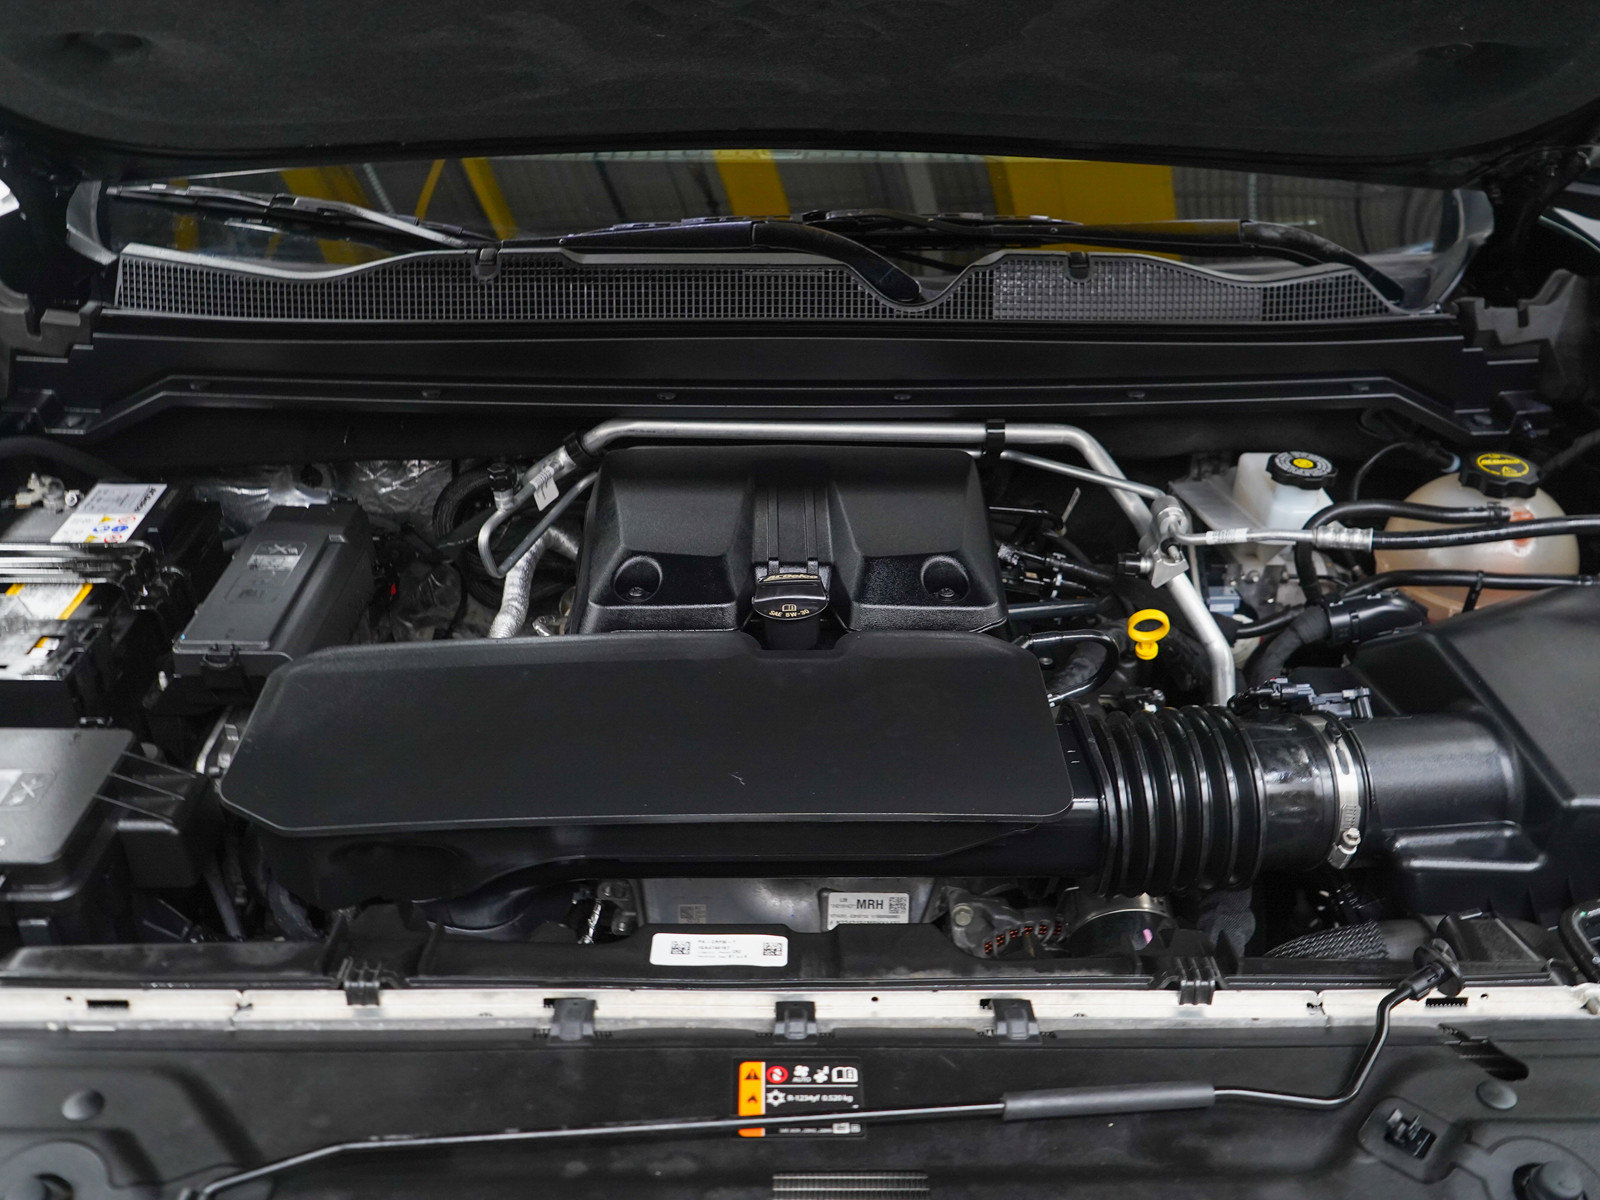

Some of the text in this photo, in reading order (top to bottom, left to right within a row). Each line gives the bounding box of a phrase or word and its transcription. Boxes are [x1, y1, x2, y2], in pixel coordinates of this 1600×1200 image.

[768, 608, 810, 618] SAE 5W-30
[856, 899, 884, 909] MRH
